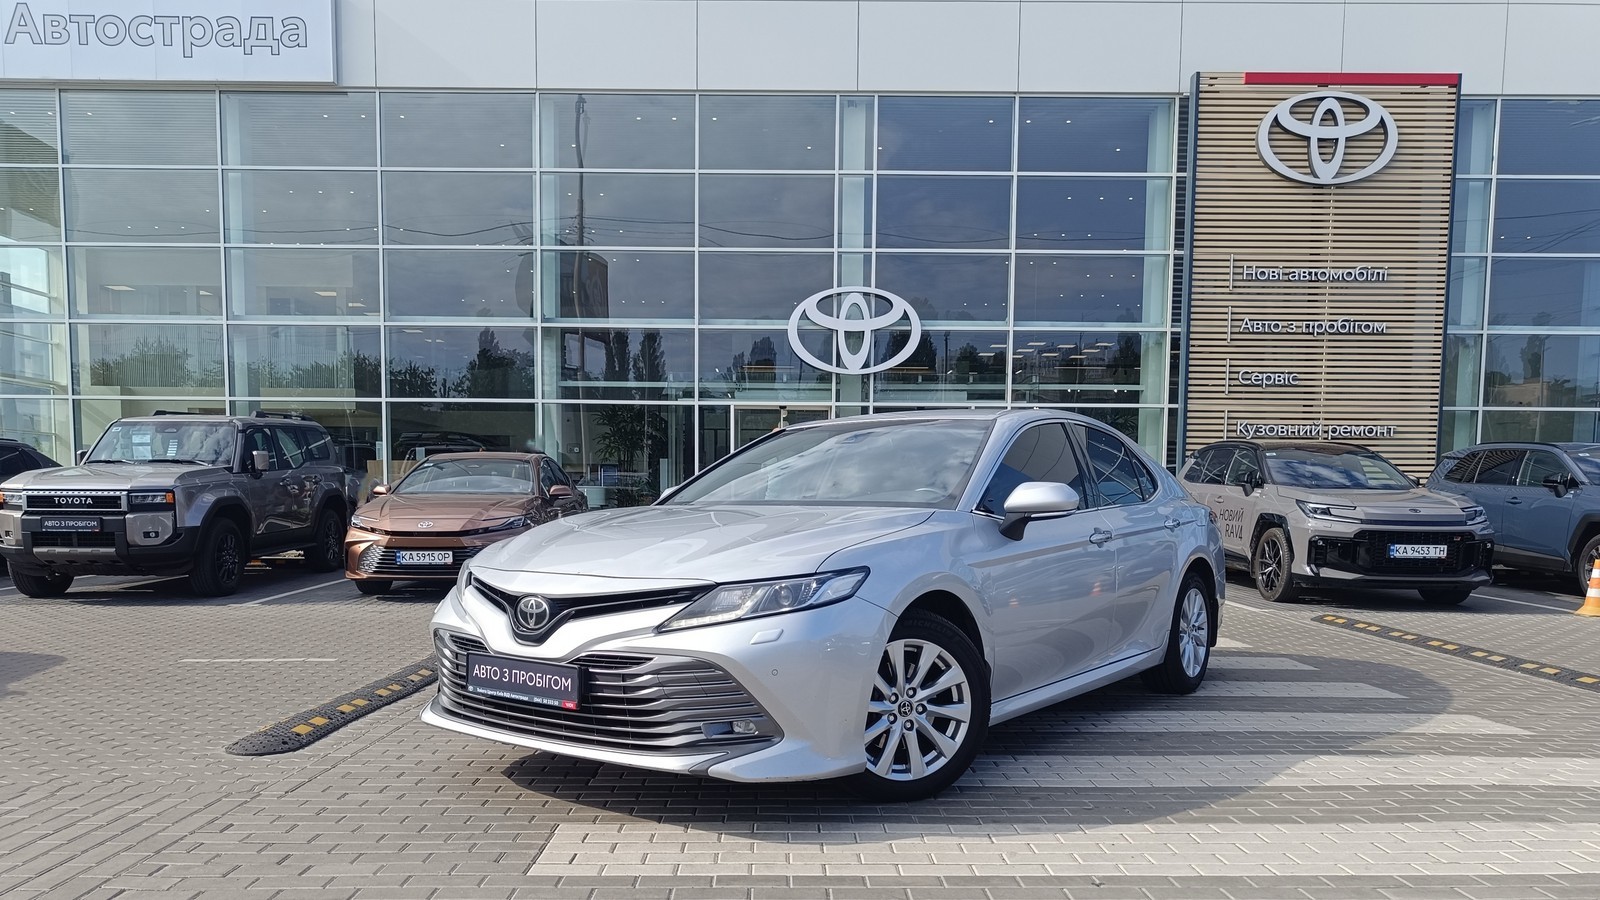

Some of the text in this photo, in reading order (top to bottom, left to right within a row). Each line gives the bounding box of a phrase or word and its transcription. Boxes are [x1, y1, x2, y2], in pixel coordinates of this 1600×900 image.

[4, 2, 307, 58] Автострада
[1242, 264, 1388, 282] Нові автомобілі
[1239, 317, 1387, 336] Авто з пробігом
[1238, 369, 1300, 389] Сервіс
[1235, 420, 1397, 440] Кузовний ремонт
[54, 497, 93, 505] TOYOTA
[1219, 507, 1244, 522] НОВИЙ
[1225, 523, 1243, 541] RAV4
[401, 552, 450, 561] KA 5915 OP
[1395, 546, 1446, 555] KA 9453 TH
[472, 664, 572, 692] АВТО З ПРОБІГОМ
